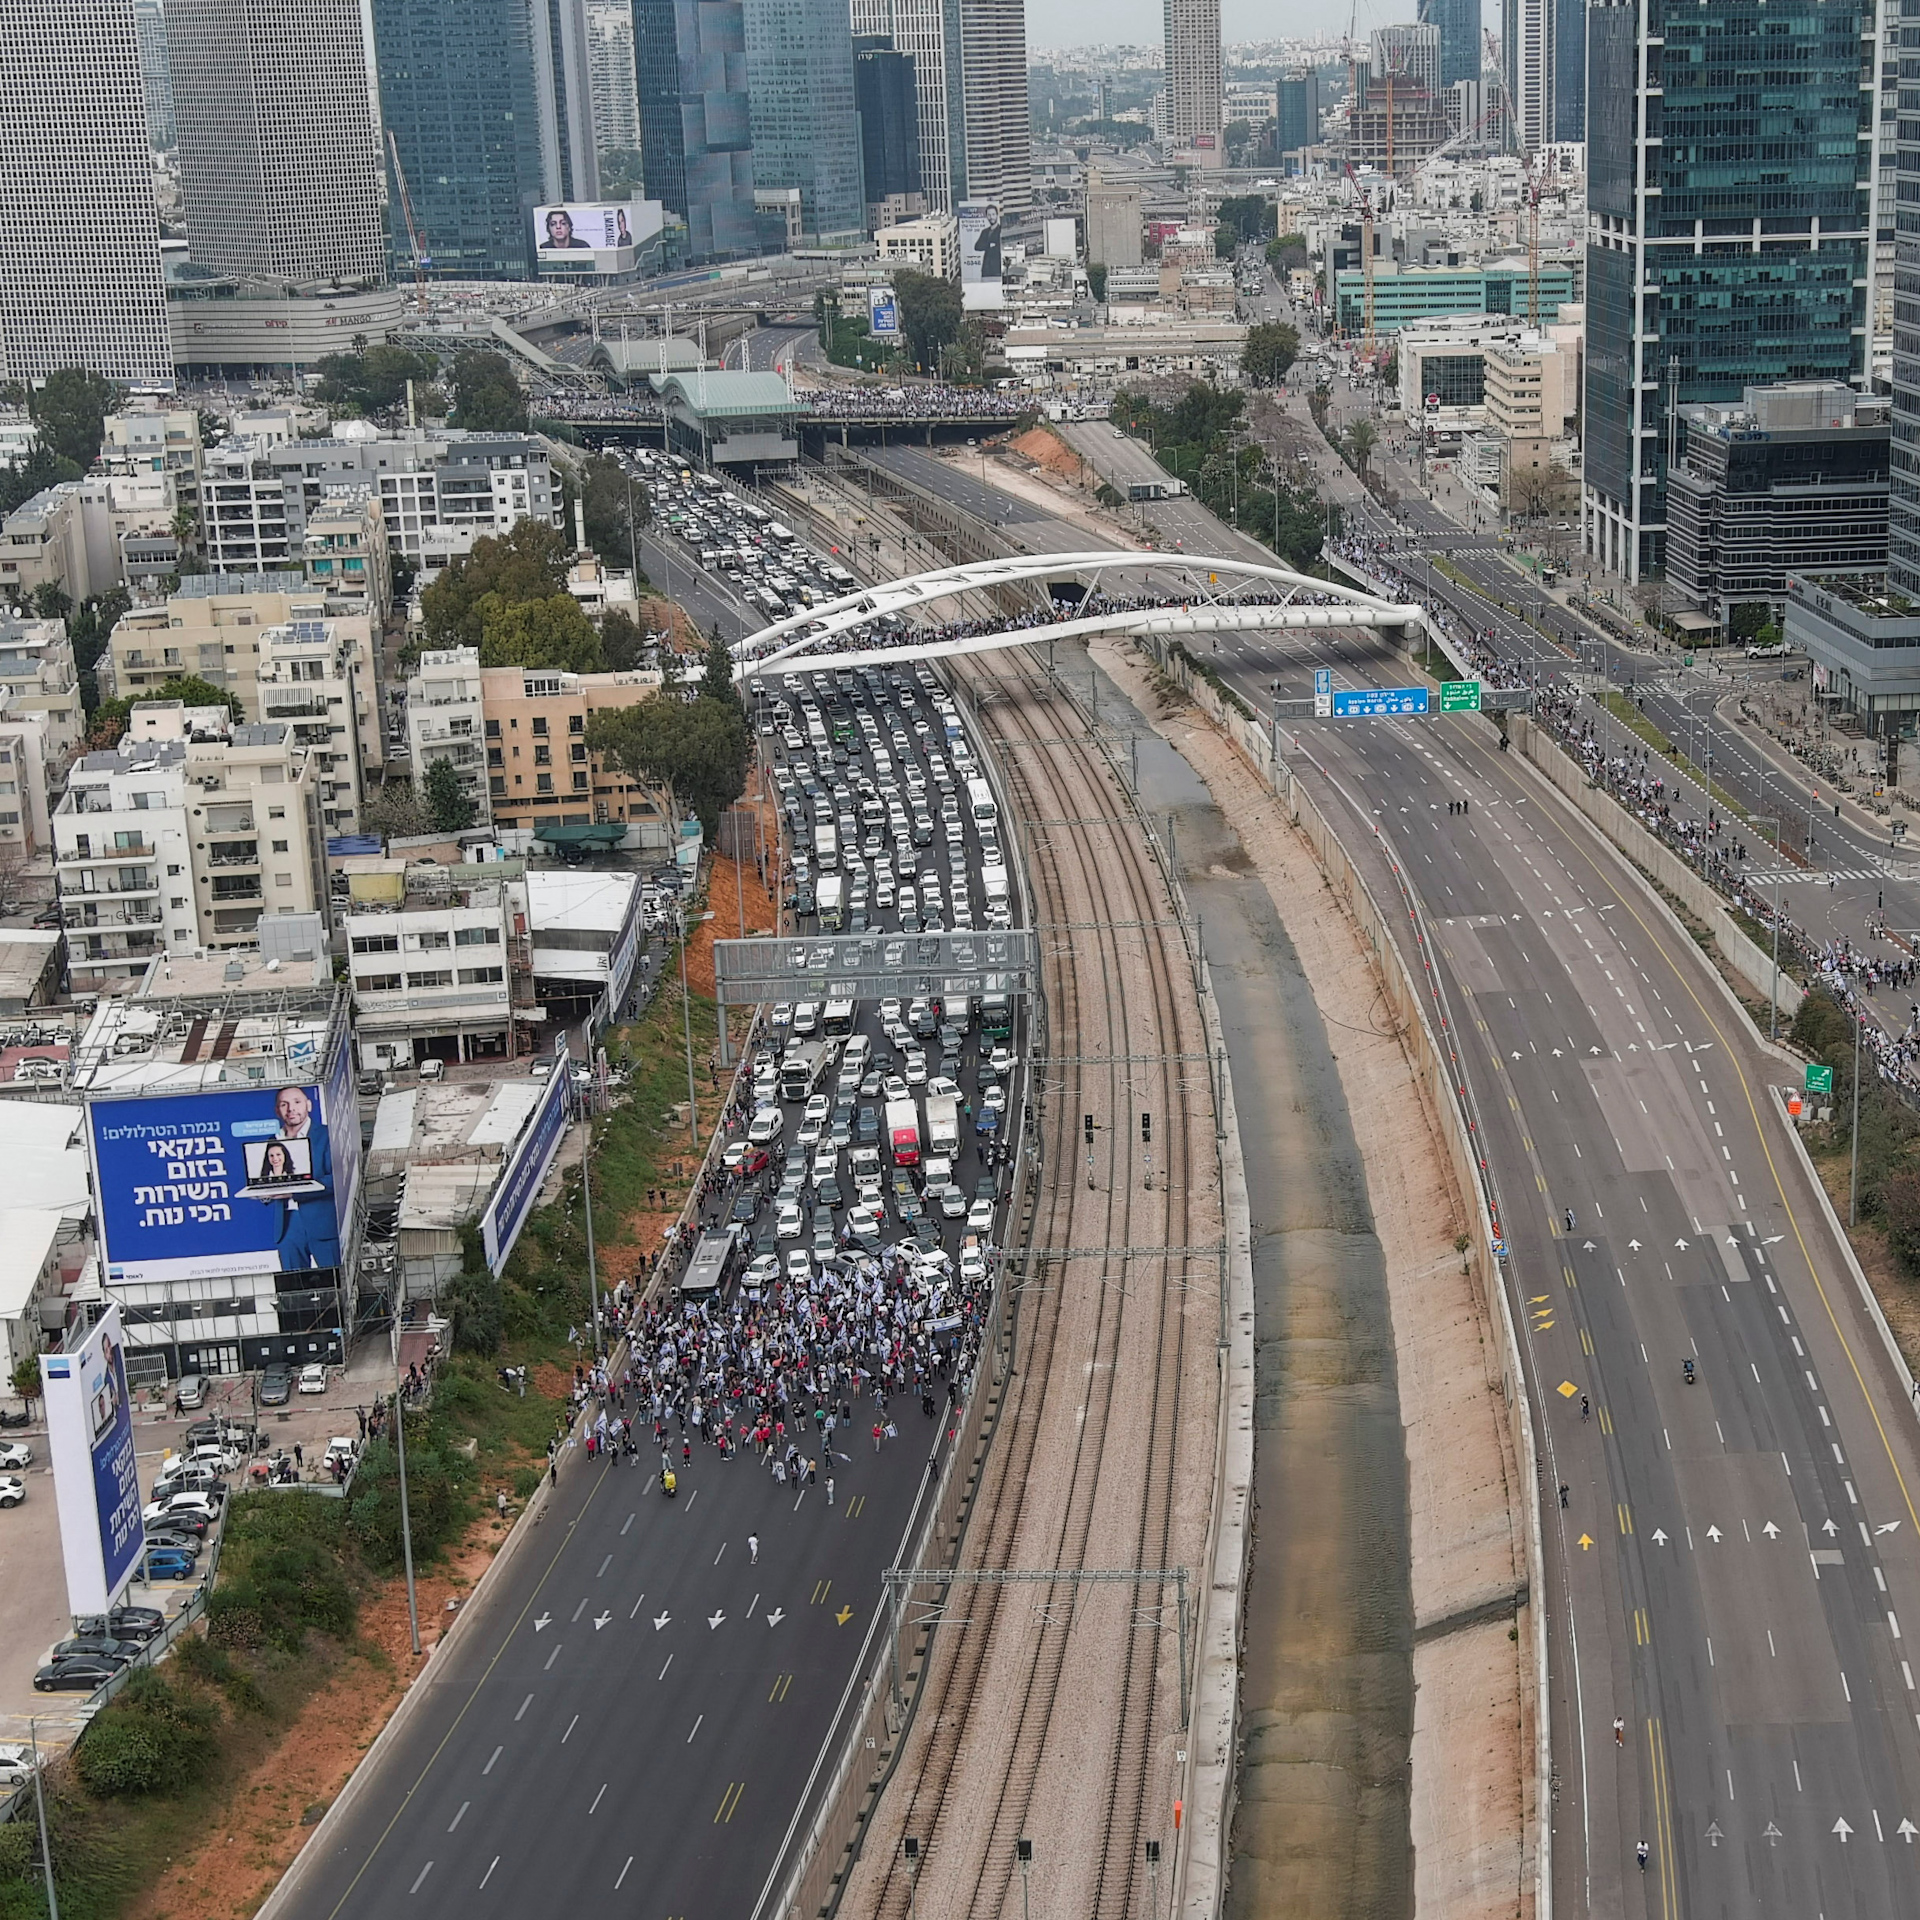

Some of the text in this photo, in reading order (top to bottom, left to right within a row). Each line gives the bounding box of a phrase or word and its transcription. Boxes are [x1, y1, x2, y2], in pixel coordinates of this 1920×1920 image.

[604, 218, 616, 247] MAKIAGE
[341, 314, 371, 325] MANGO
[102, 1120, 221, 1140] נגמרו הטרלולים!
[147, 1136, 225, 1160] בנקאי
[168, 1159, 227, 1180] בזום
[133, 1181, 228, 1205] השירות
[139, 1203, 231, 1228] הכי נוח.
[125, 1272, 144, 1280] לאומי
[111, 1437, 132, 1478] בנקאי
[118, 1459, 135, 1497] בזום
[109, 1481, 137, 1534] השירות
[128, 1502, 139, 1531] הכי
